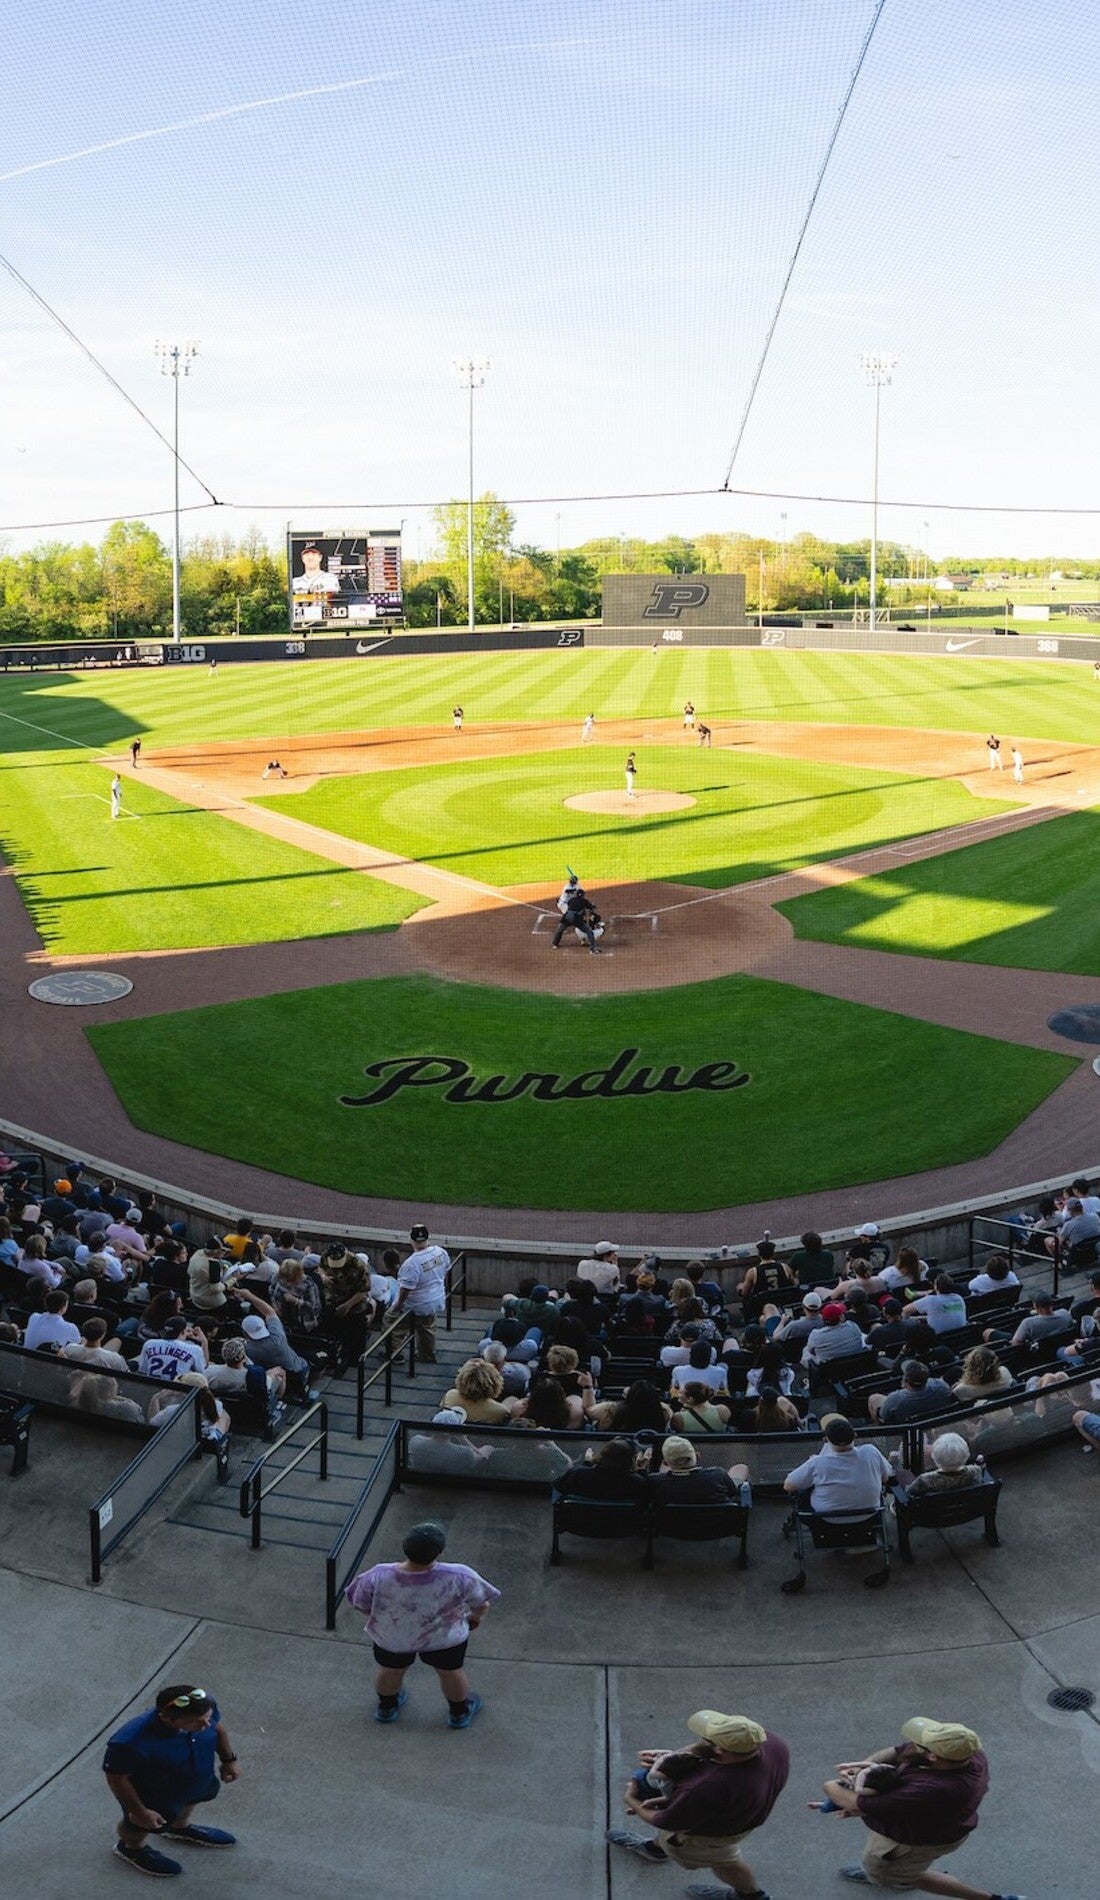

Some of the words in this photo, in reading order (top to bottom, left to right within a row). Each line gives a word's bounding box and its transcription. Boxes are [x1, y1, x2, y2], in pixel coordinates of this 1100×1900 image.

[642, 583, 709, 618] P
[558, 630, 581, 646] P
[662, 630, 683, 641] 408
[762, 630, 785, 645] P
[338, 1048, 752, 1107] Purdue
[149, 1357, 178, 1380] 24
